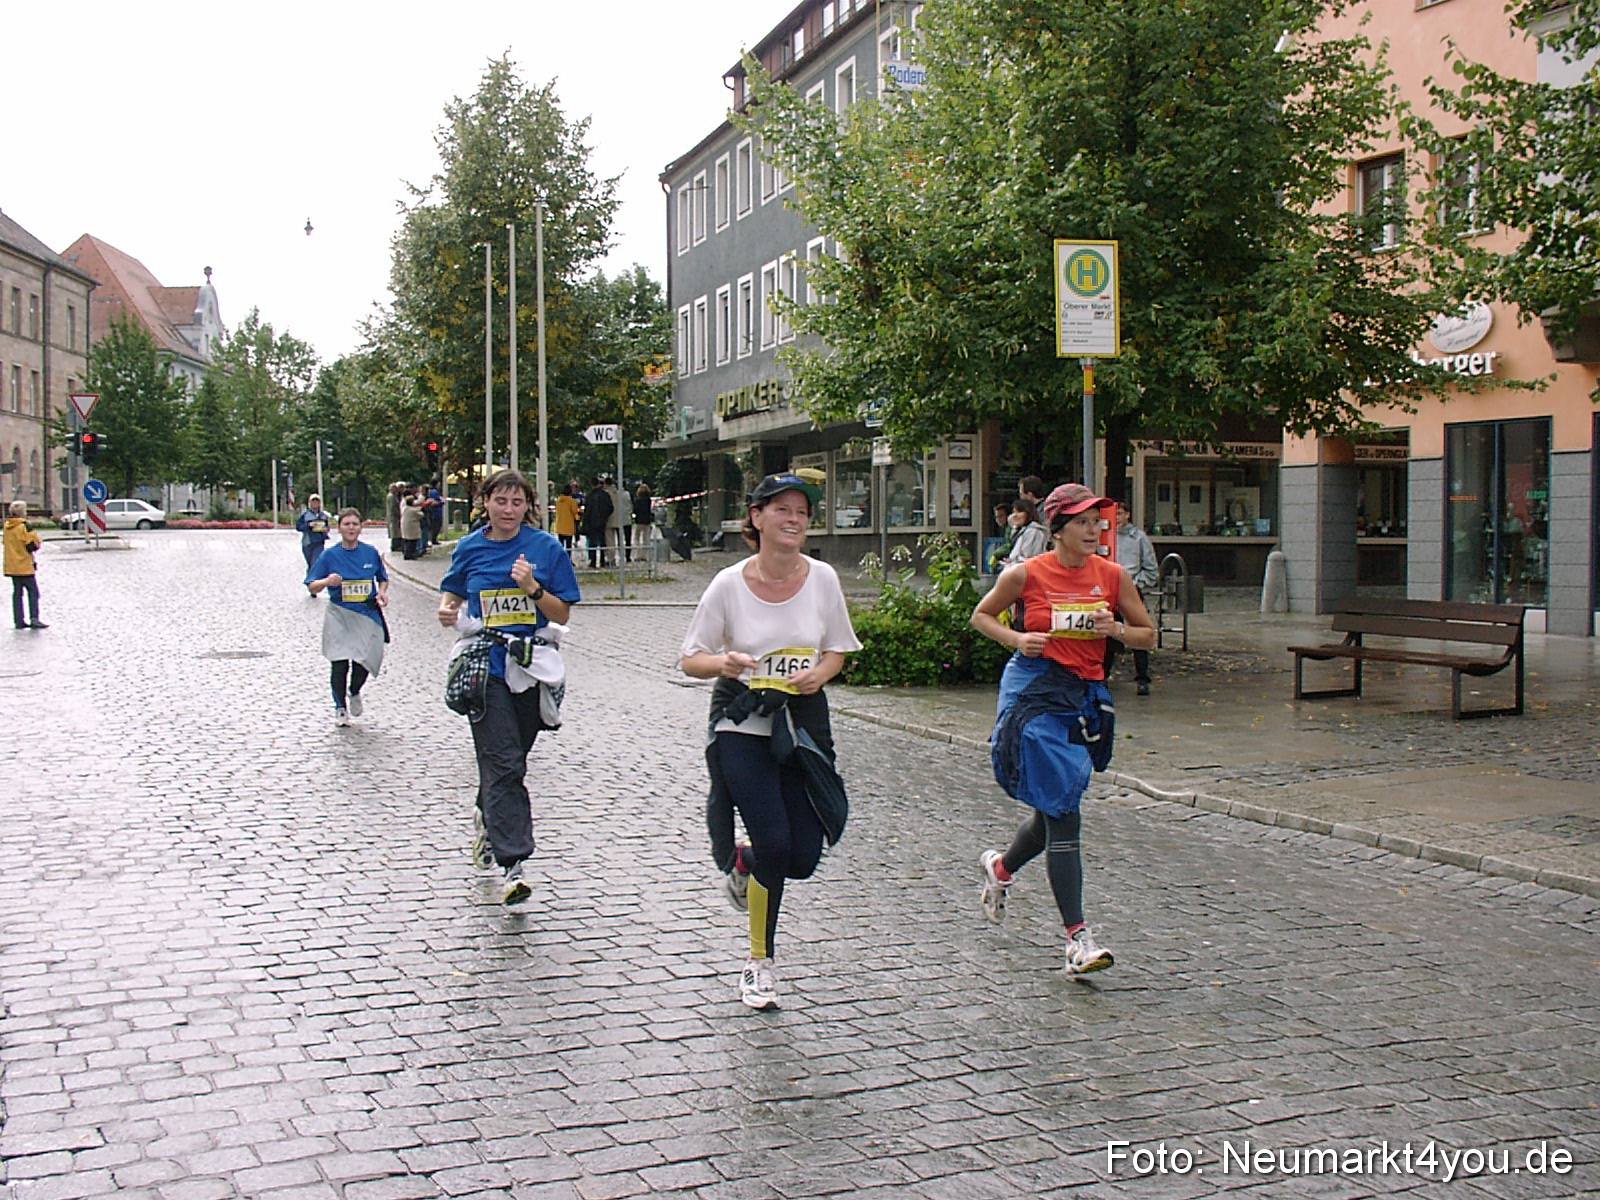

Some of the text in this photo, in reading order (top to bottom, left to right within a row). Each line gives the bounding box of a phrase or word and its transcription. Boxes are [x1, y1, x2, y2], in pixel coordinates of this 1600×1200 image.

[888, 64, 928, 84] Roden
[1077, 260, 1098, 286] H
[1063, 302, 1111, 310] Oberer Markt
[716, 376, 779, 418] OPTIKER
[593, 427, 614, 442] WC
[348, 584, 370, 594] 1416
[492, 596, 529, 613] 1421
